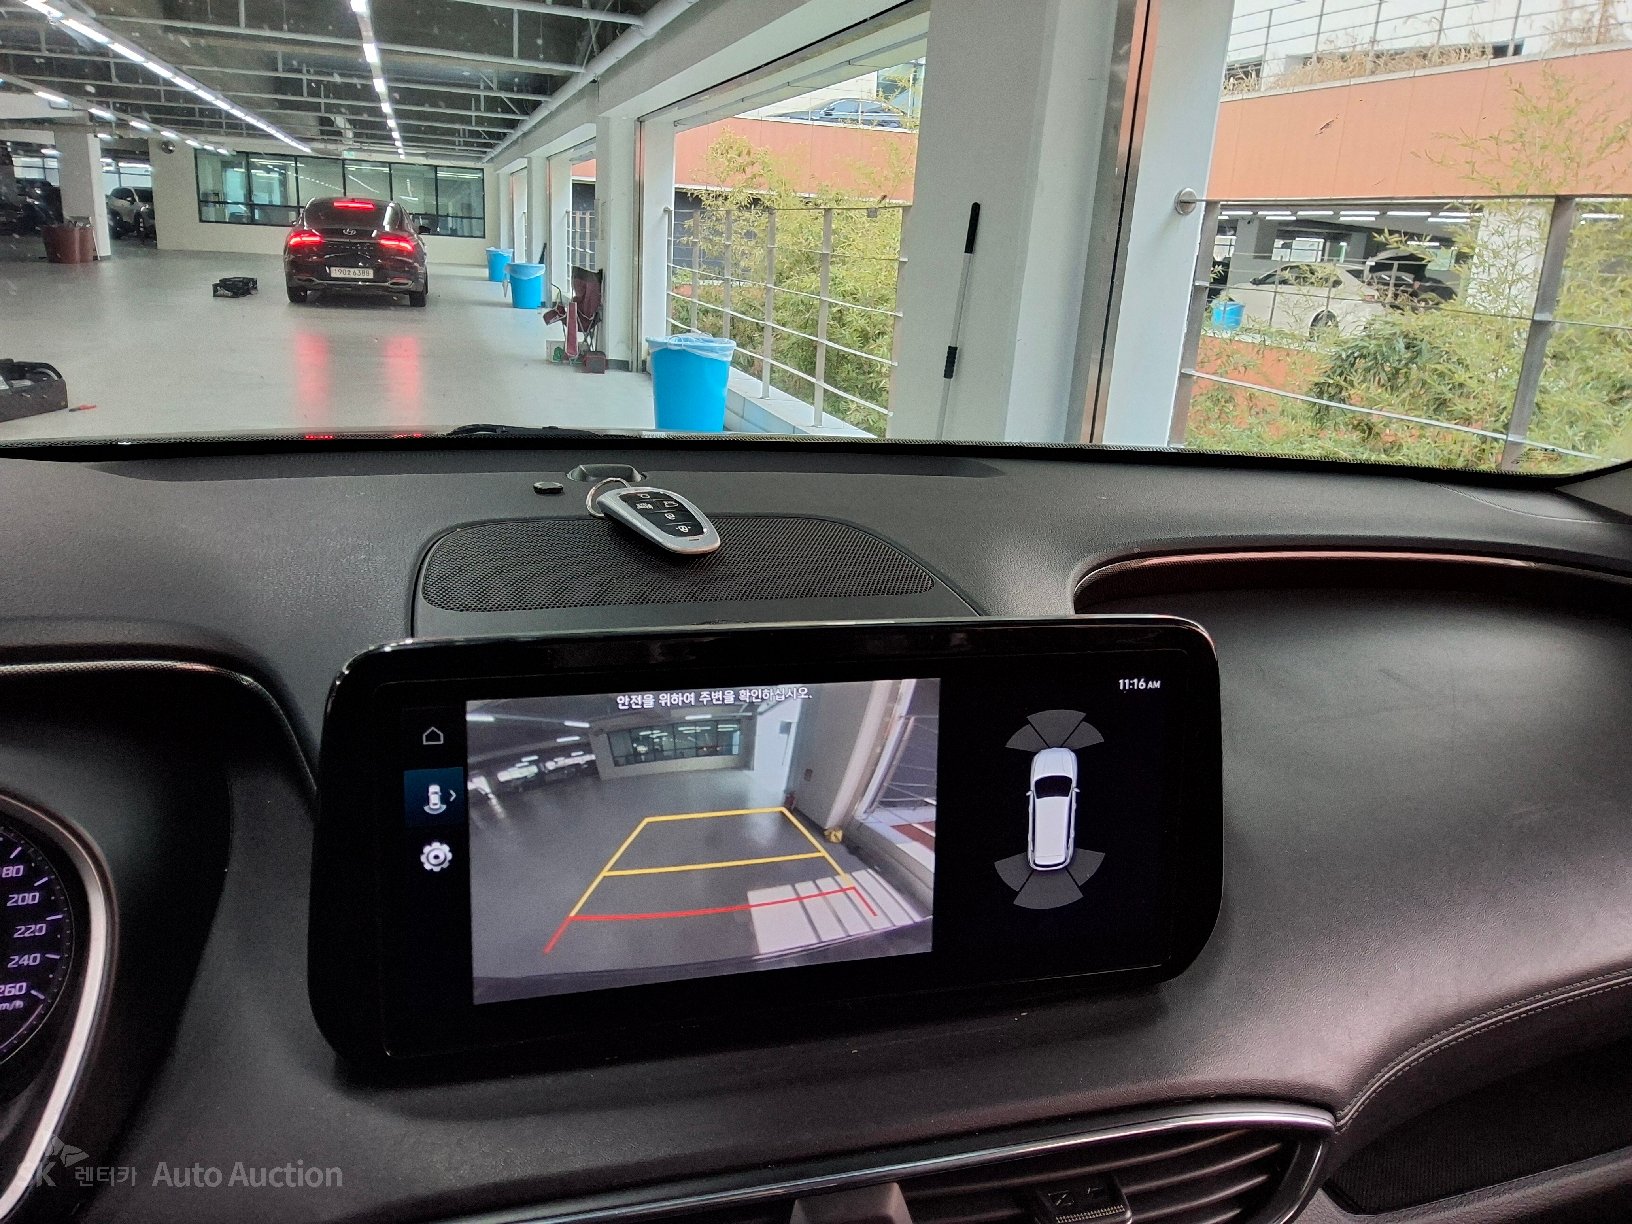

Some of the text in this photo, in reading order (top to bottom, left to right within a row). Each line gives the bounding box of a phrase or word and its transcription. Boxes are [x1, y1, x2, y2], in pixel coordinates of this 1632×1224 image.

[1118, 678, 1161, 690] 11:16 AM
[616, 686, 813, 710] 안전을 위하여 주변을 확인하십시오.
[0, 865, 24, 878] 80
[6, 892, 40, 907] 200
[13, 923, 47, 938] 220
[7, 953, 41, 968] 240
[0, 1000, 24, 1011] m/h
